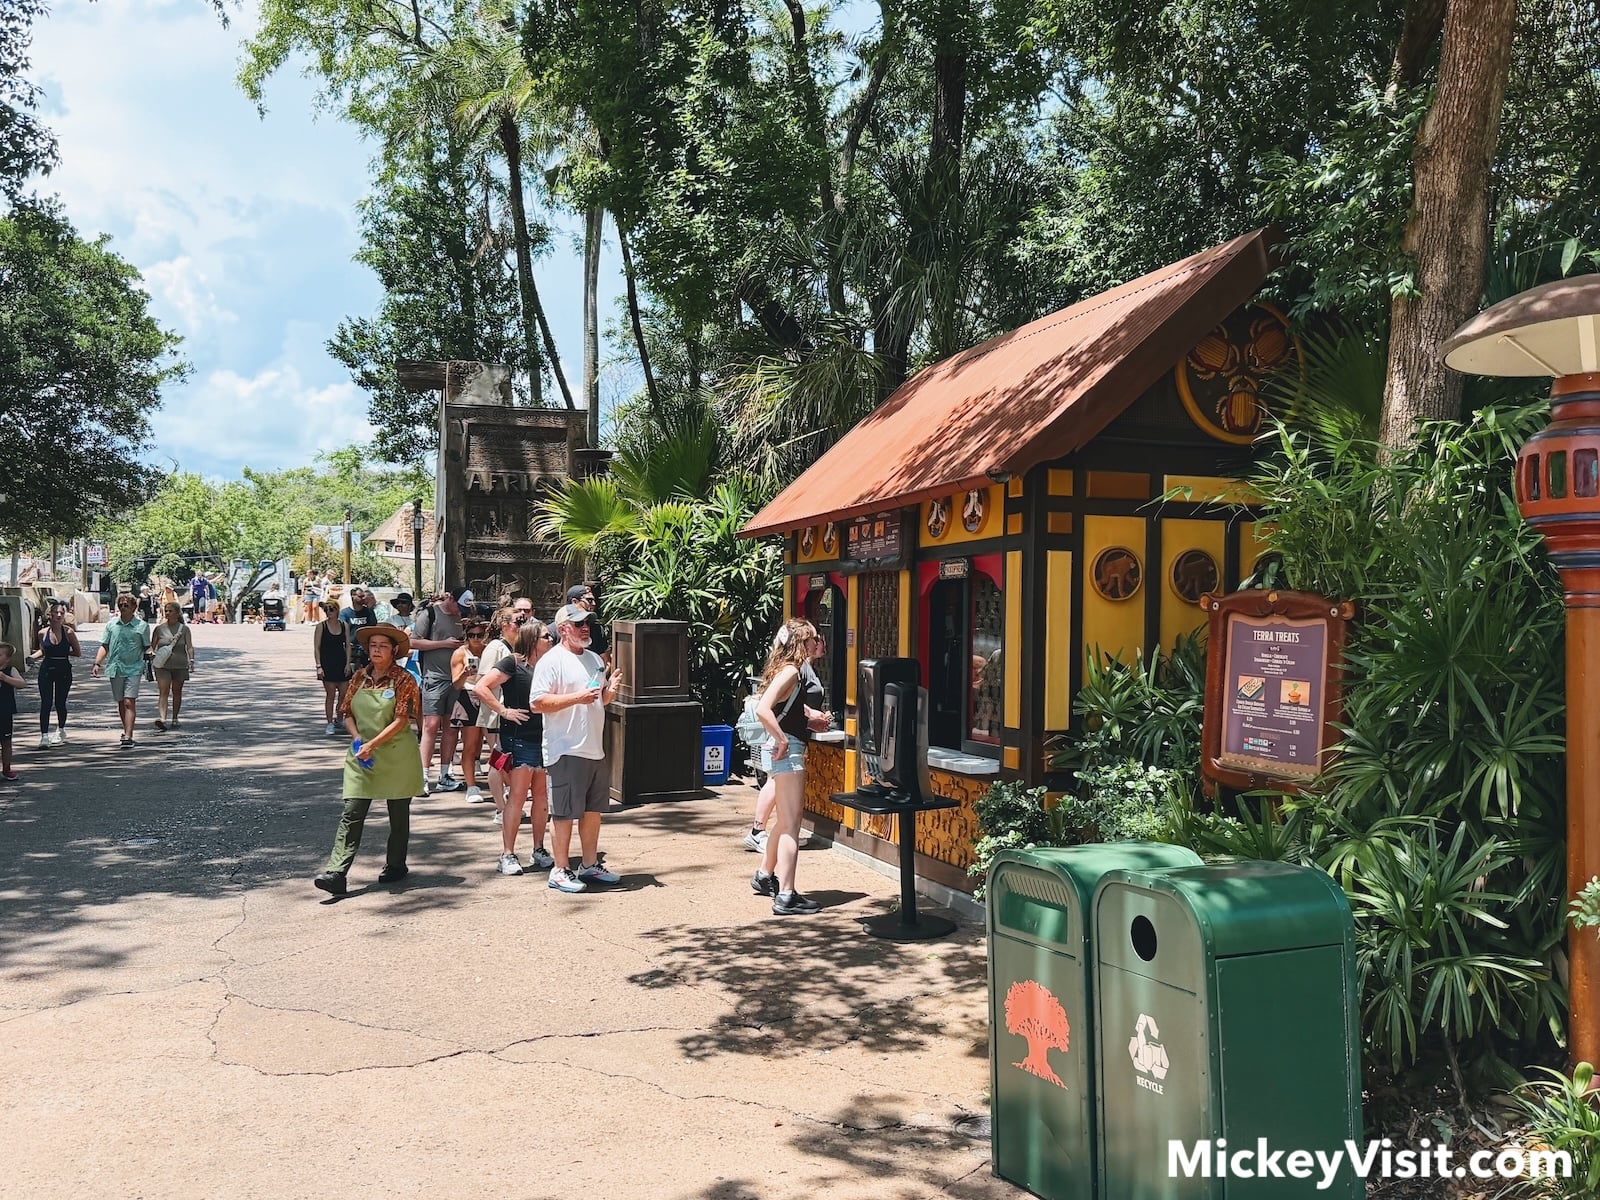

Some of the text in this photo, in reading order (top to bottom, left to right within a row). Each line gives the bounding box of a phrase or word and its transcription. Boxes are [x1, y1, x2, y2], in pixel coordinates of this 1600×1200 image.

[465, 471, 566, 495] AFRIC
[1253, 630, 1300, 643] TERRA TREATS
[1136, 1075, 1164, 1095] RECYCLE
